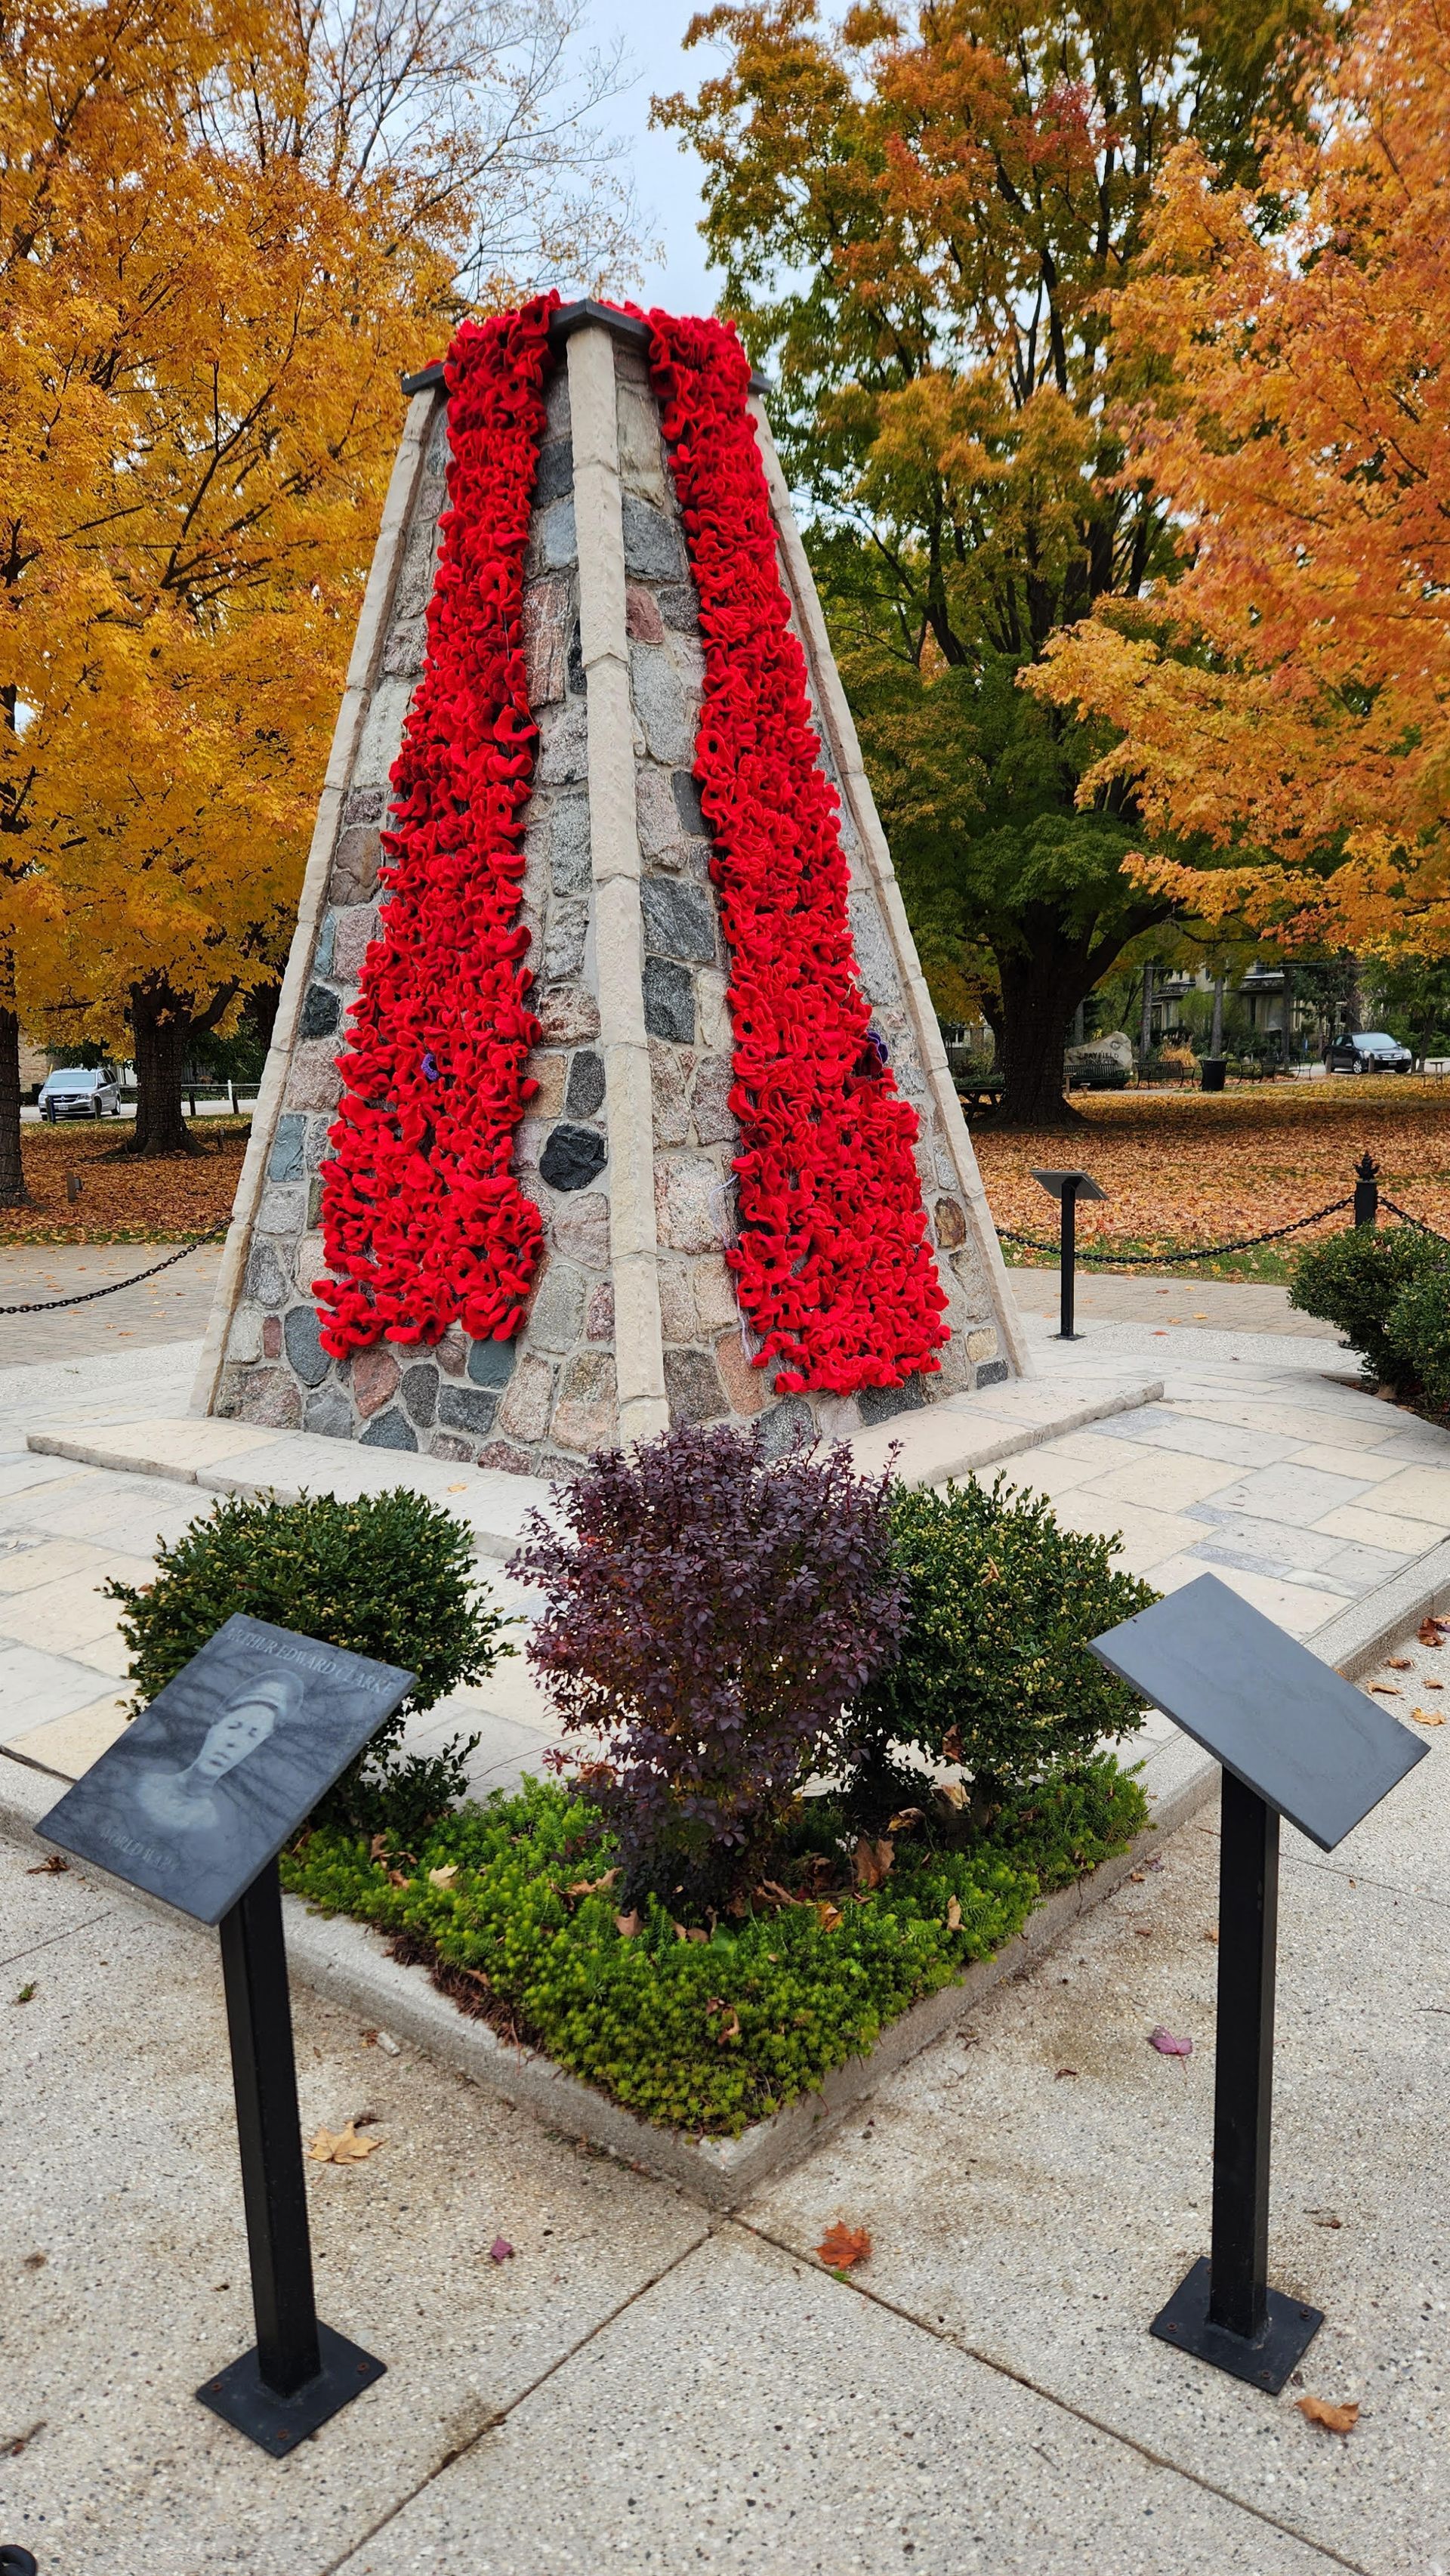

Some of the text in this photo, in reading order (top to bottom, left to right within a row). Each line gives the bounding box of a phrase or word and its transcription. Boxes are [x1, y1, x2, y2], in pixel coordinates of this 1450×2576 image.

[227, 1627, 396, 1697] ARTHUR EDWARD CLARKE
[99, 1828, 144, 1857] WORLD
